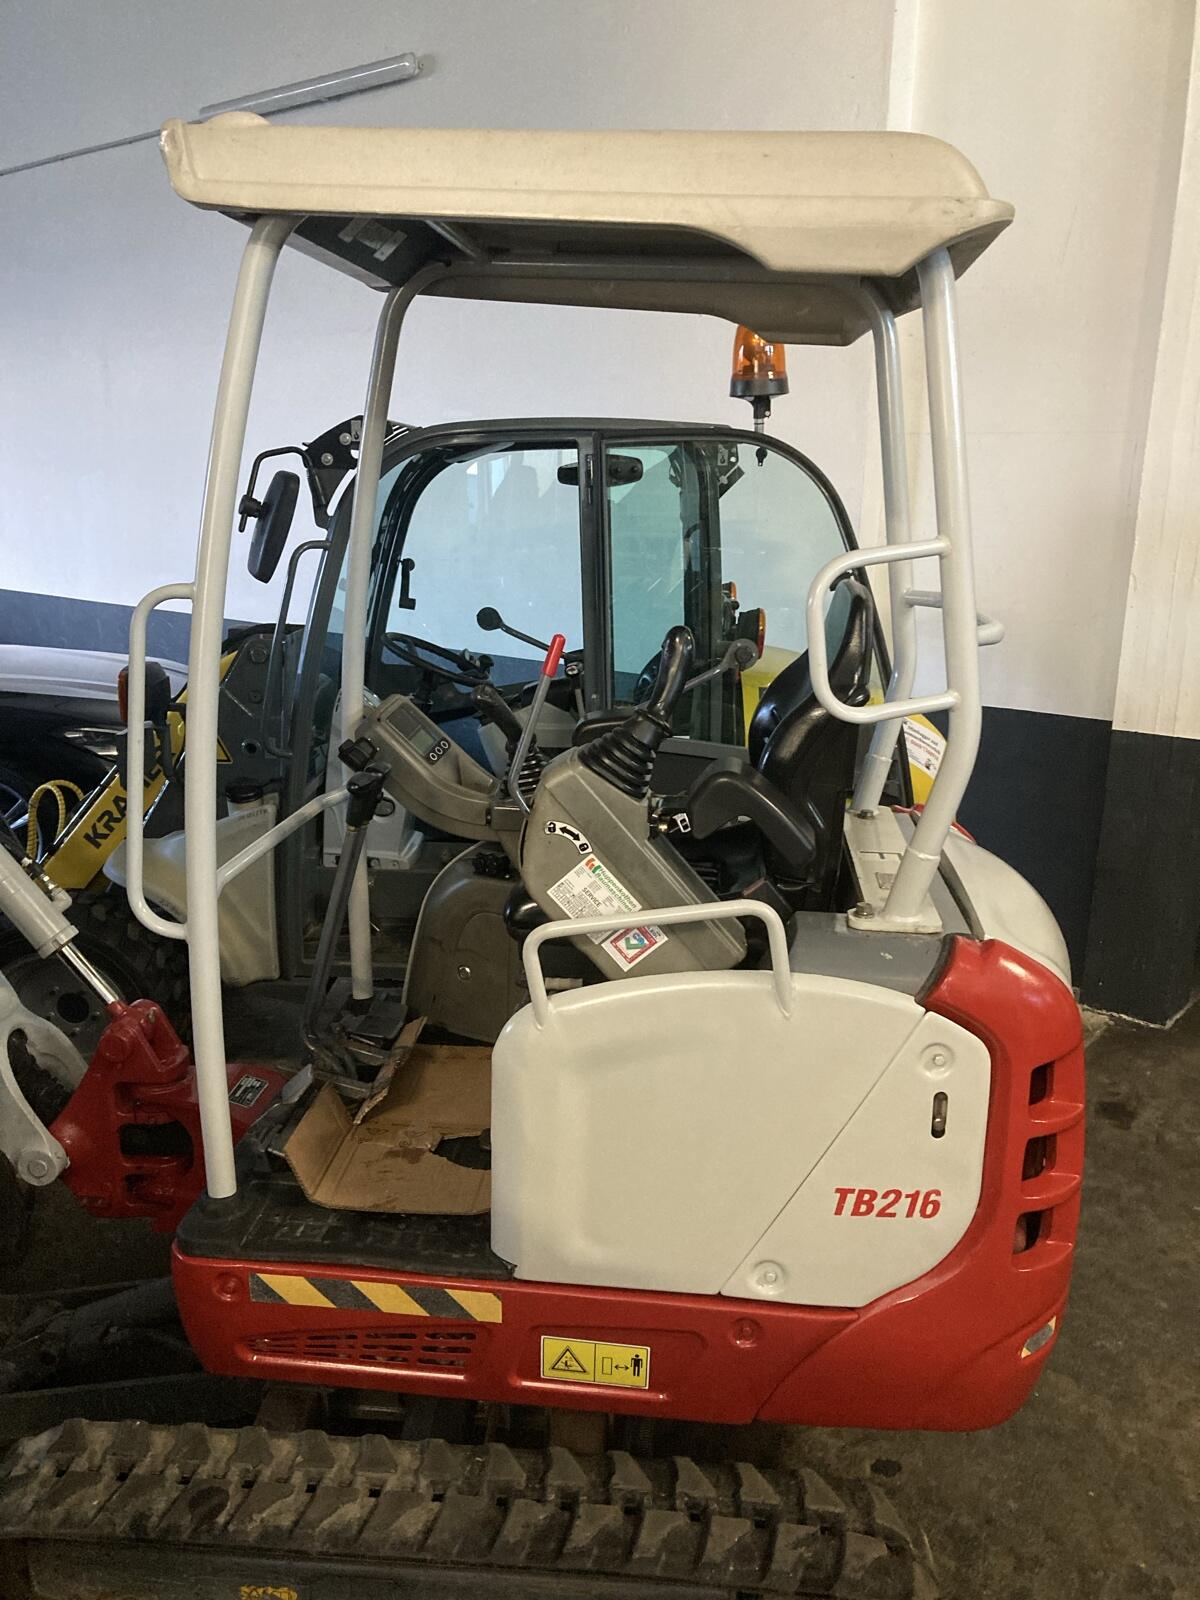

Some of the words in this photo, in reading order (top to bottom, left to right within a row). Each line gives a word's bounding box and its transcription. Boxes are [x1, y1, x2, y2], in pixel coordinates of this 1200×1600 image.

[582, 886, 602, 908] SERVICE
[595, 873, 633, 912] Baumaschinen
[599, 867, 637, 909] Huppenkothen
[834, 1187, 942, 1219] TB216
